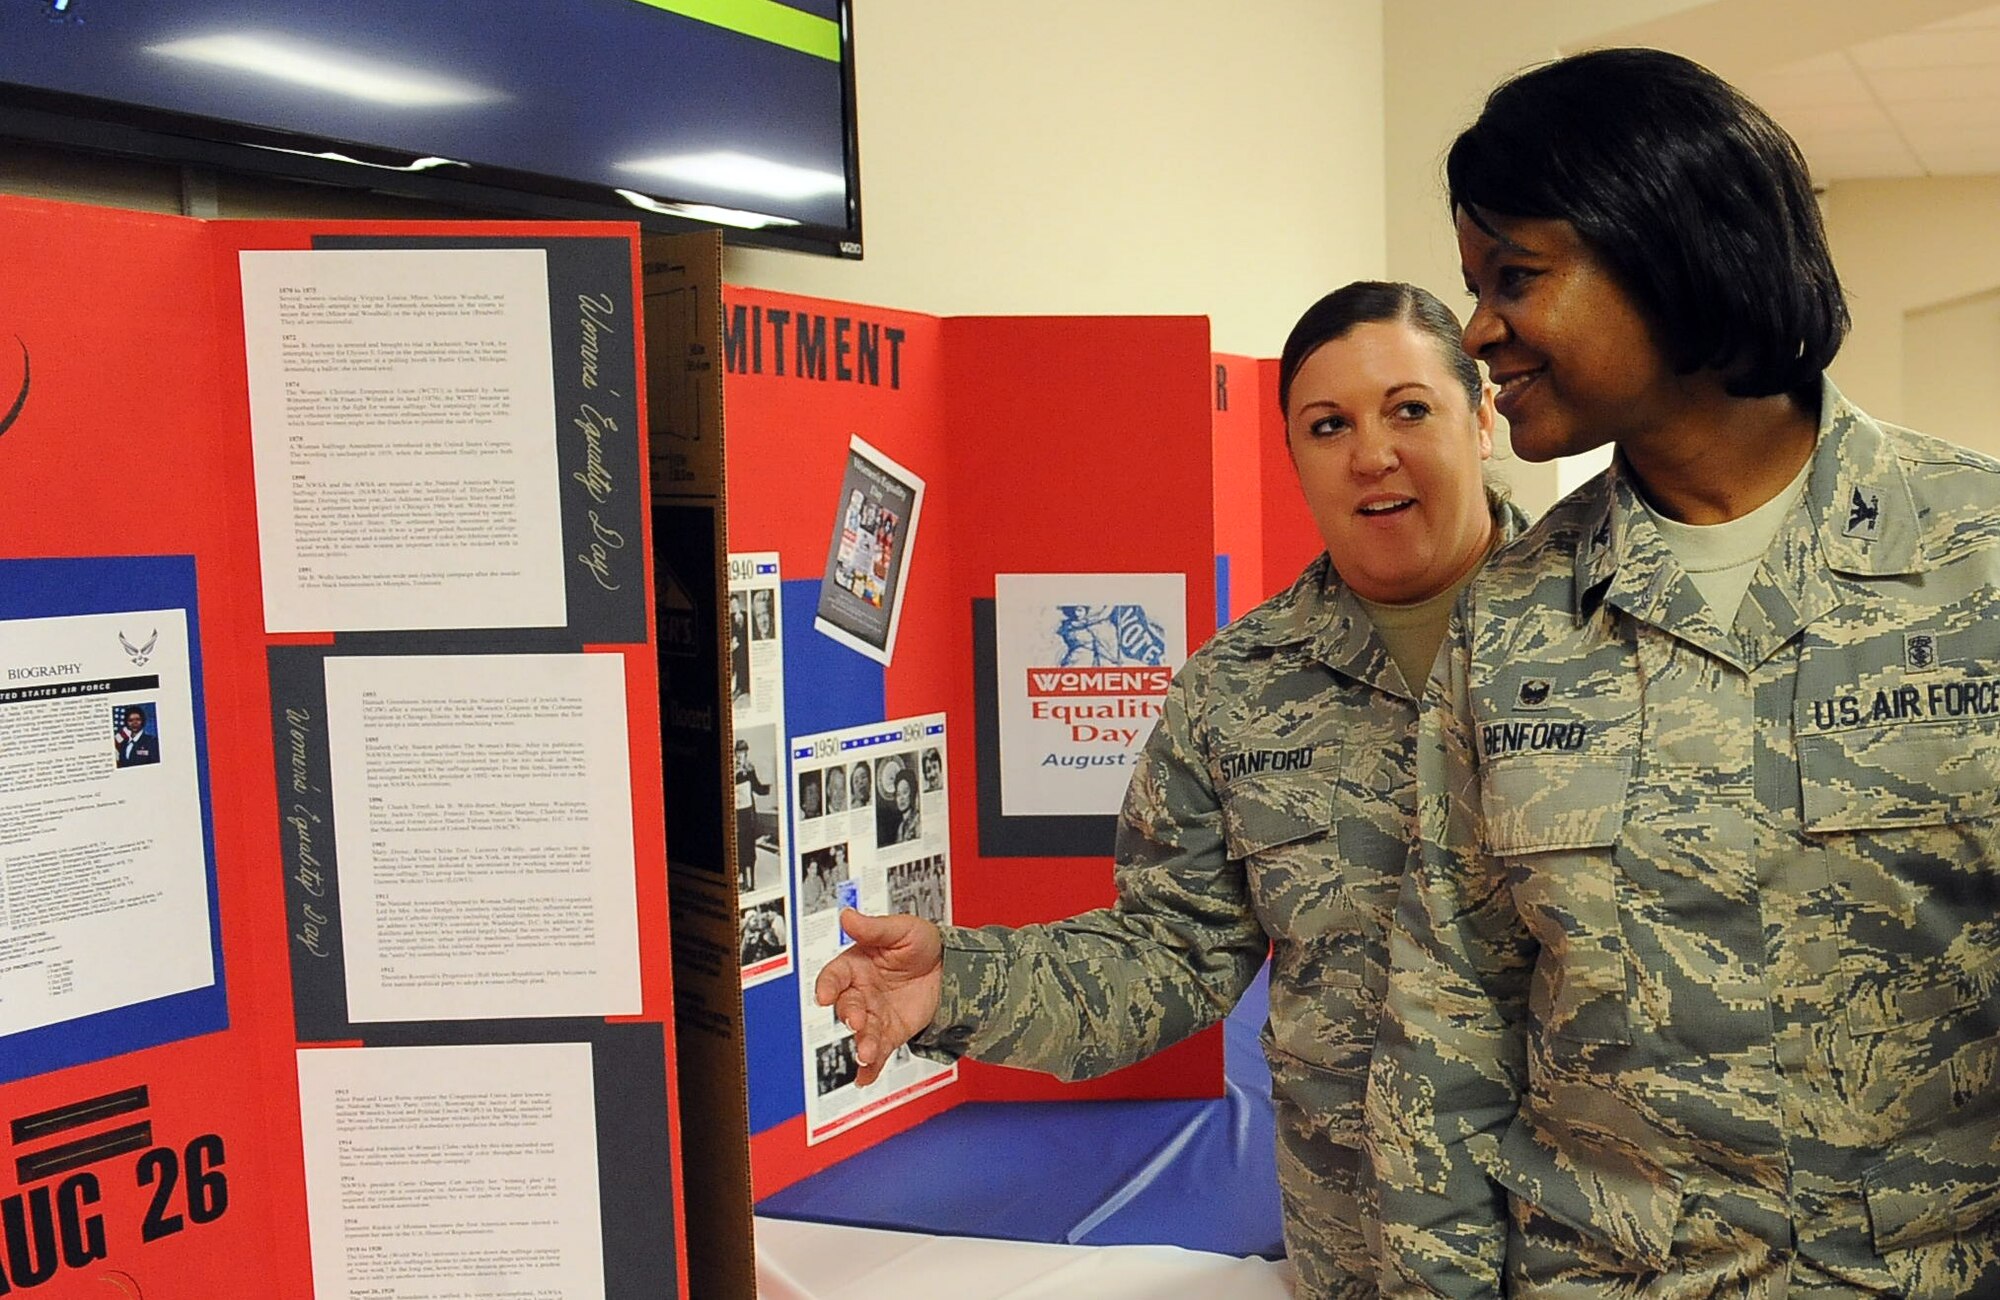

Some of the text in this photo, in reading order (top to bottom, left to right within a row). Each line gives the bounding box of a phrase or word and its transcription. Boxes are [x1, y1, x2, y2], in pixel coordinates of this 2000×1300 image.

[579, 510, 624, 590] Day
[1120, 607, 1162, 663] VOTE
[8, 663, 82, 680] BIOGRAPHY
[22, 688, 57, 699] STATES
[61, 685, 77, 695] AIR
[80, 683, 111, 693] FORCE
[1873, 683, 1923, 721] AIR
[1927, 680, 2000, 716] FORCE
[813, 738, 839, 759] 1950
[902, 722, 924, 742] 1960
[1072, 725, 1139, 747] Day
[1482, 722, 1586, 756] BENFORD
[1041, 753, 1125, 770] August
[1220, 747, 1314, 783] STANFORD
[287, 804, 325, 897] Equality
[295, 903, 329, 958] Day
[136, 1133, 228, 1244] 26
[0, 1172, 107, 1297] UG
